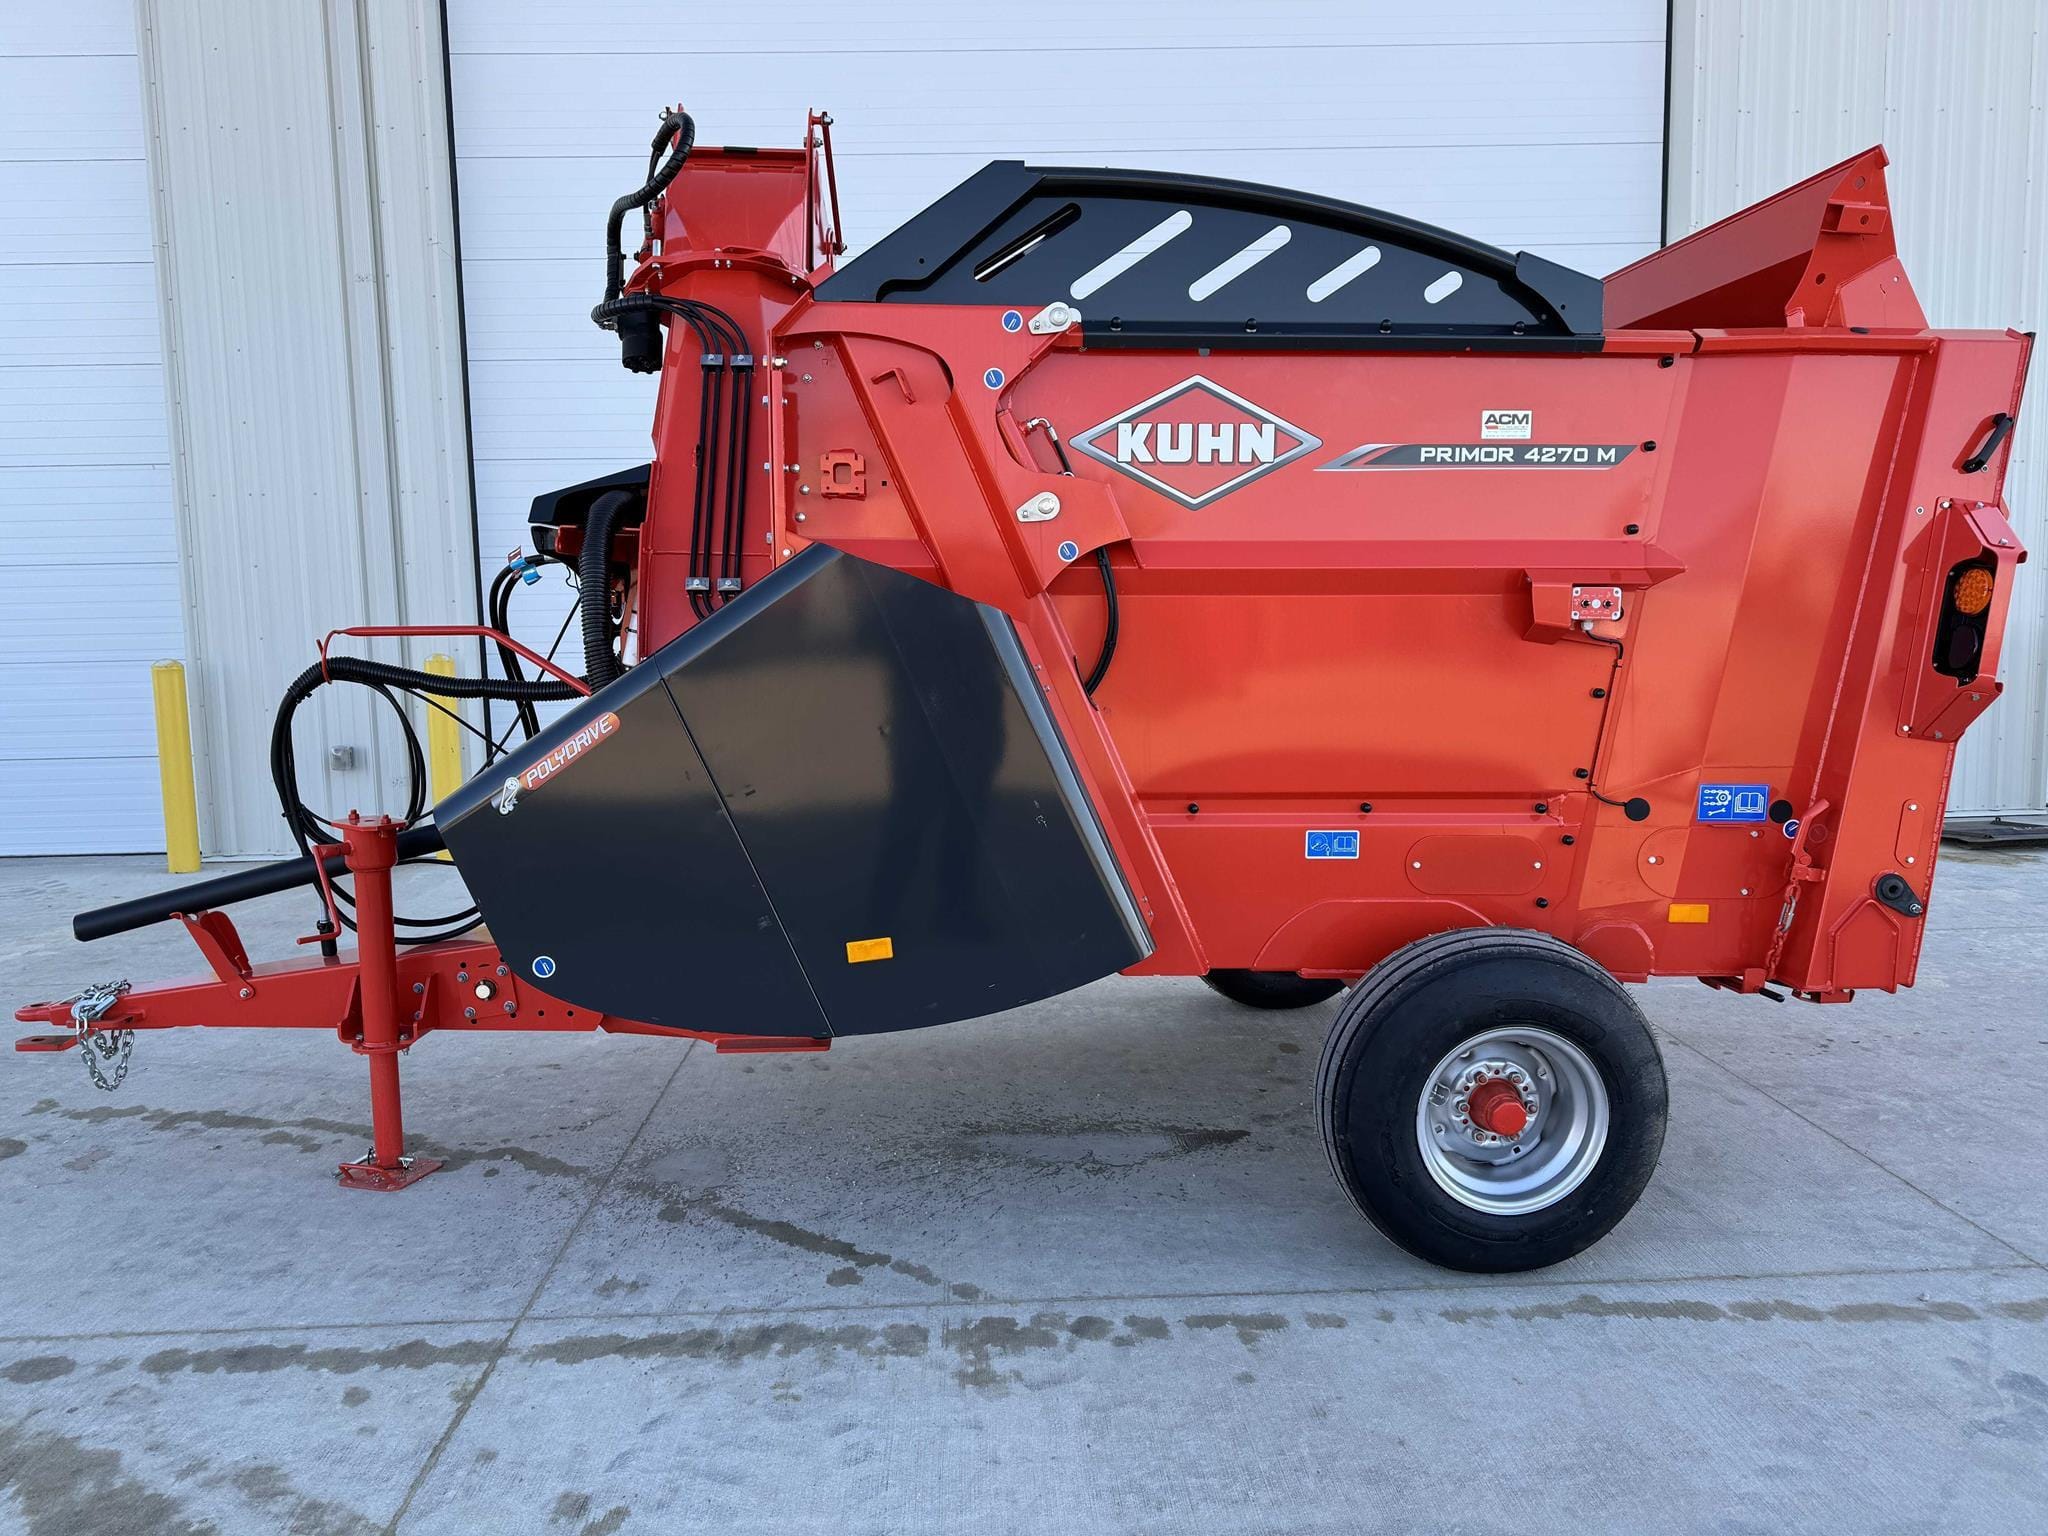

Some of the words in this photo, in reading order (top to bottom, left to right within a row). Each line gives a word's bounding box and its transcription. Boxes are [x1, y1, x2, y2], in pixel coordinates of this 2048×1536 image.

[1484, 413, 1530, 425] ACM
[1116, 422, 1276, 464] KUHN
[1419, 447, 1515, 463] PRIMOR
[1524, 447, 1589, 463] 4270
[1597, 447, 1616, 463] M
[526, 714, 613, 788] POLYDRIVE
